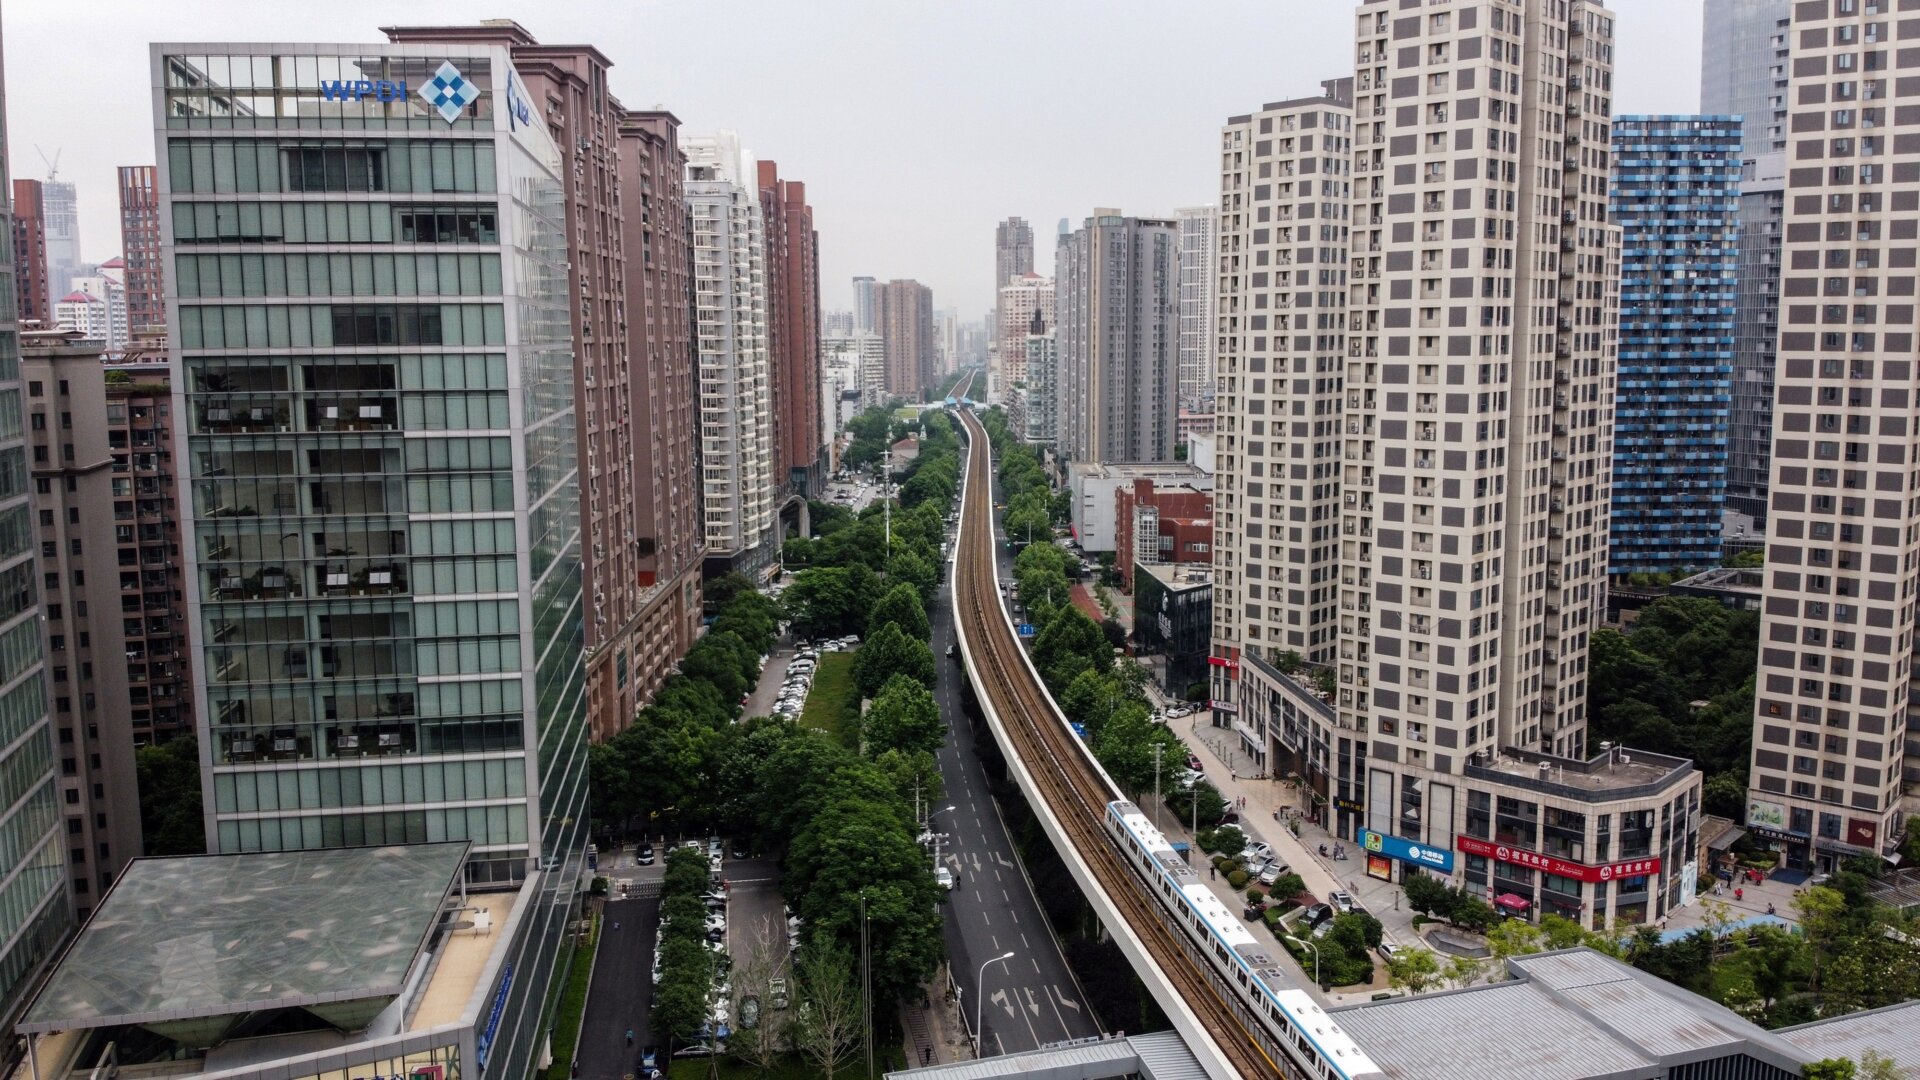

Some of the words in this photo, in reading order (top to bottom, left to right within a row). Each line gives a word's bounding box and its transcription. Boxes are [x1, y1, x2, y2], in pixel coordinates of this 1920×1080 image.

[321, 80, 407, 103] WPDI
[1512, 851, 1549, 867] 招商银行
